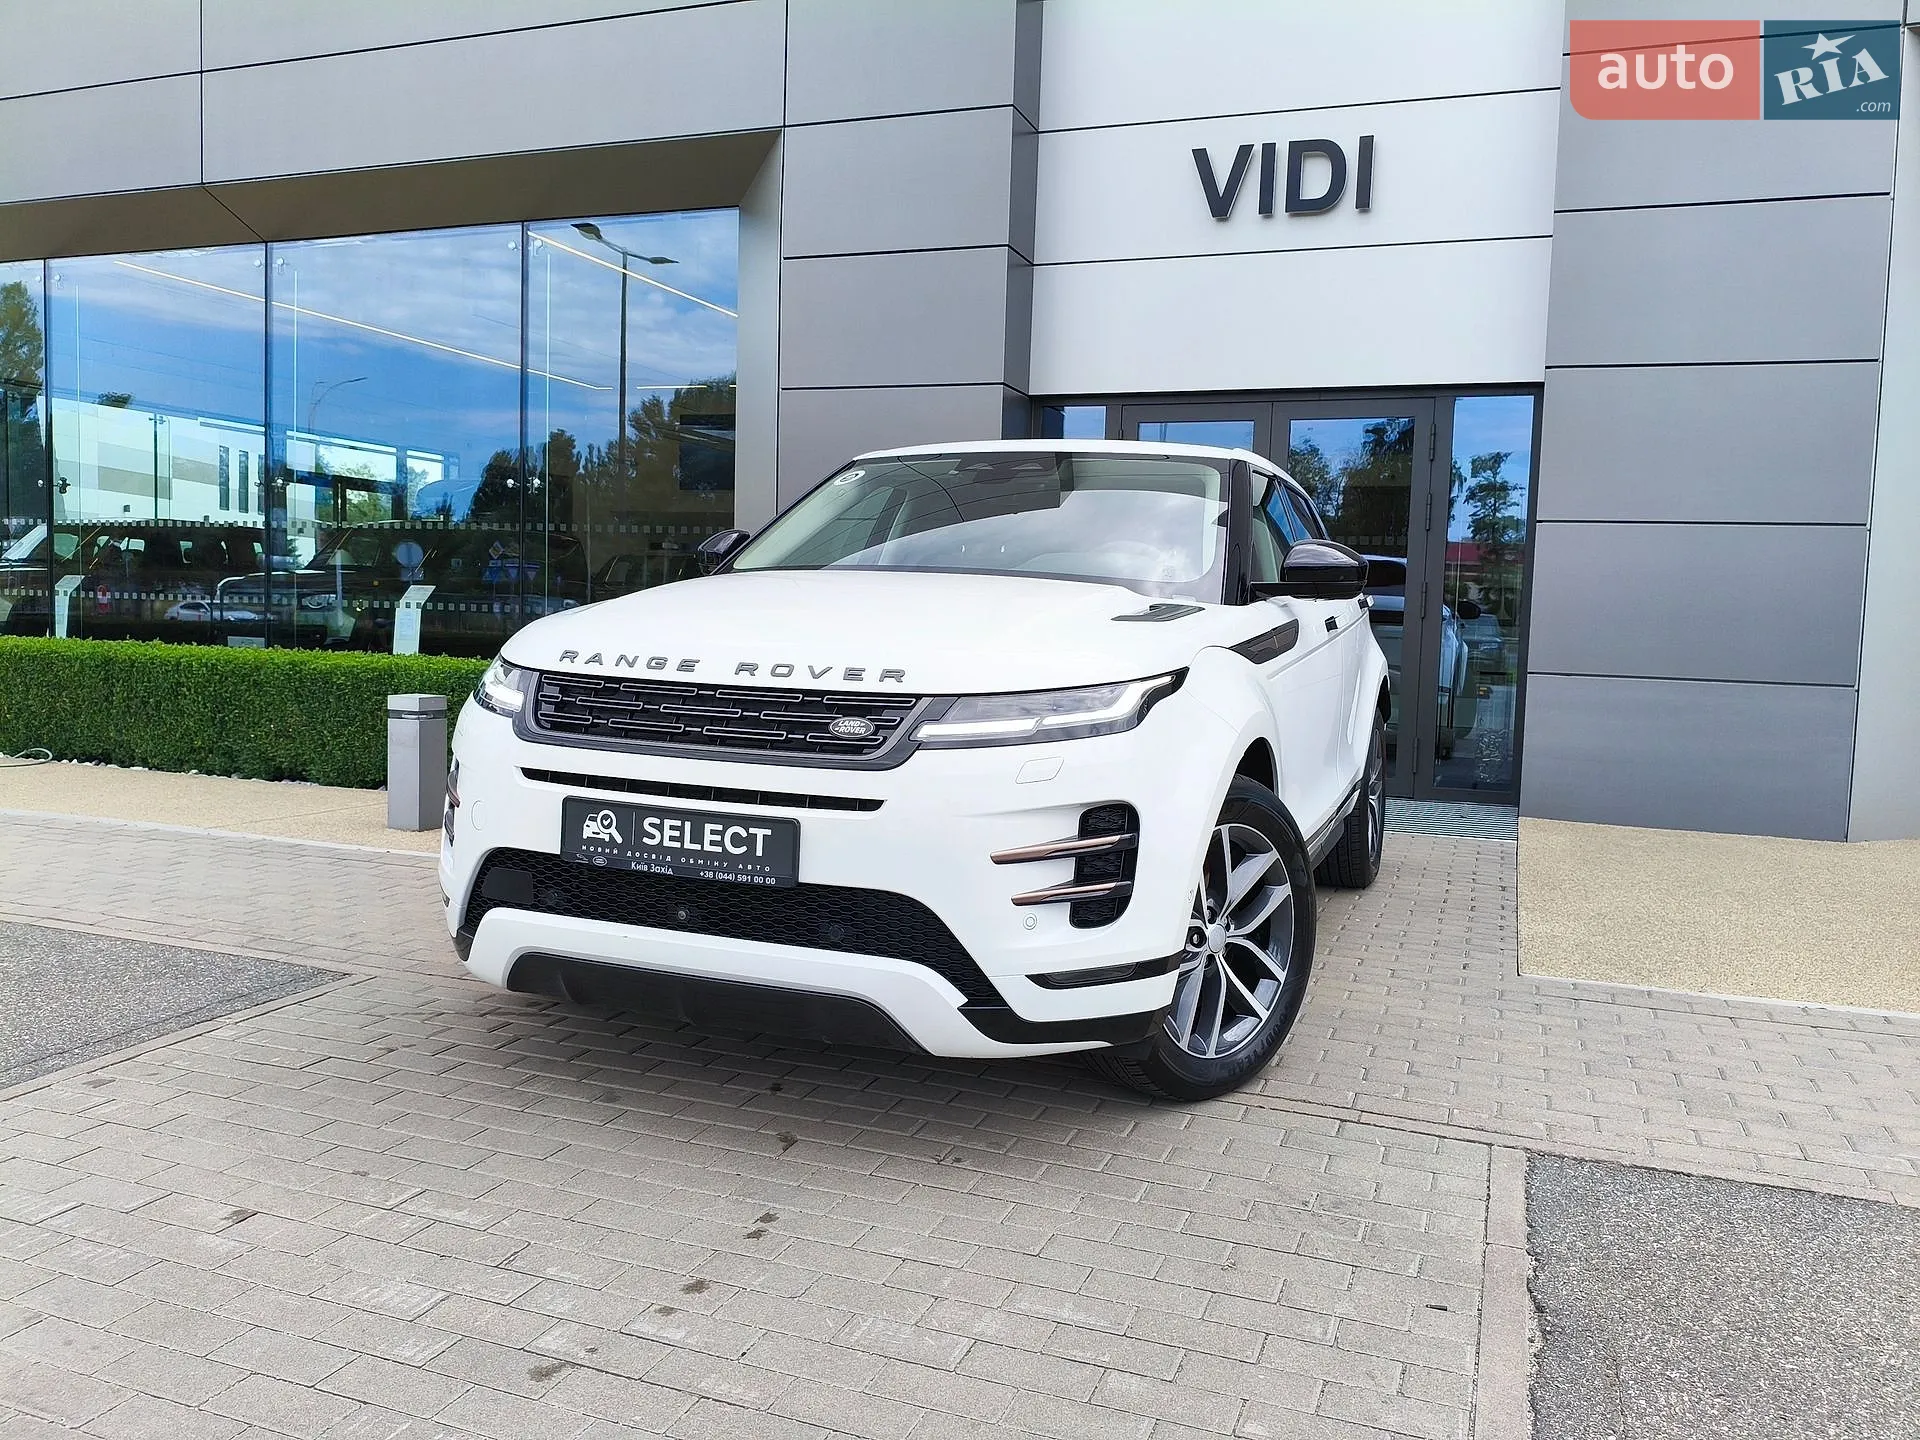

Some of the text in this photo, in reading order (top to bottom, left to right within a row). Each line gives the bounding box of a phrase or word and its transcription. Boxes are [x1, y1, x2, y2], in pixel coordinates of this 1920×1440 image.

[1191, 135, 1375, 218] VIDI
[559, 650, 906, 683] RANGE ROVER
[838, 726, 866, 734] ROVER
[642, 817, 772, 857] SELECT
[582, 845, 770, 872] НОВИЙ ДОСВІД ОБМІНУ АВТО
[631, 861, 674, 875] Київ Захід
[715, 872, 735, 881] (044)
[754, 876, 764, 884] 00
[766, 877, 776, 885] 00
